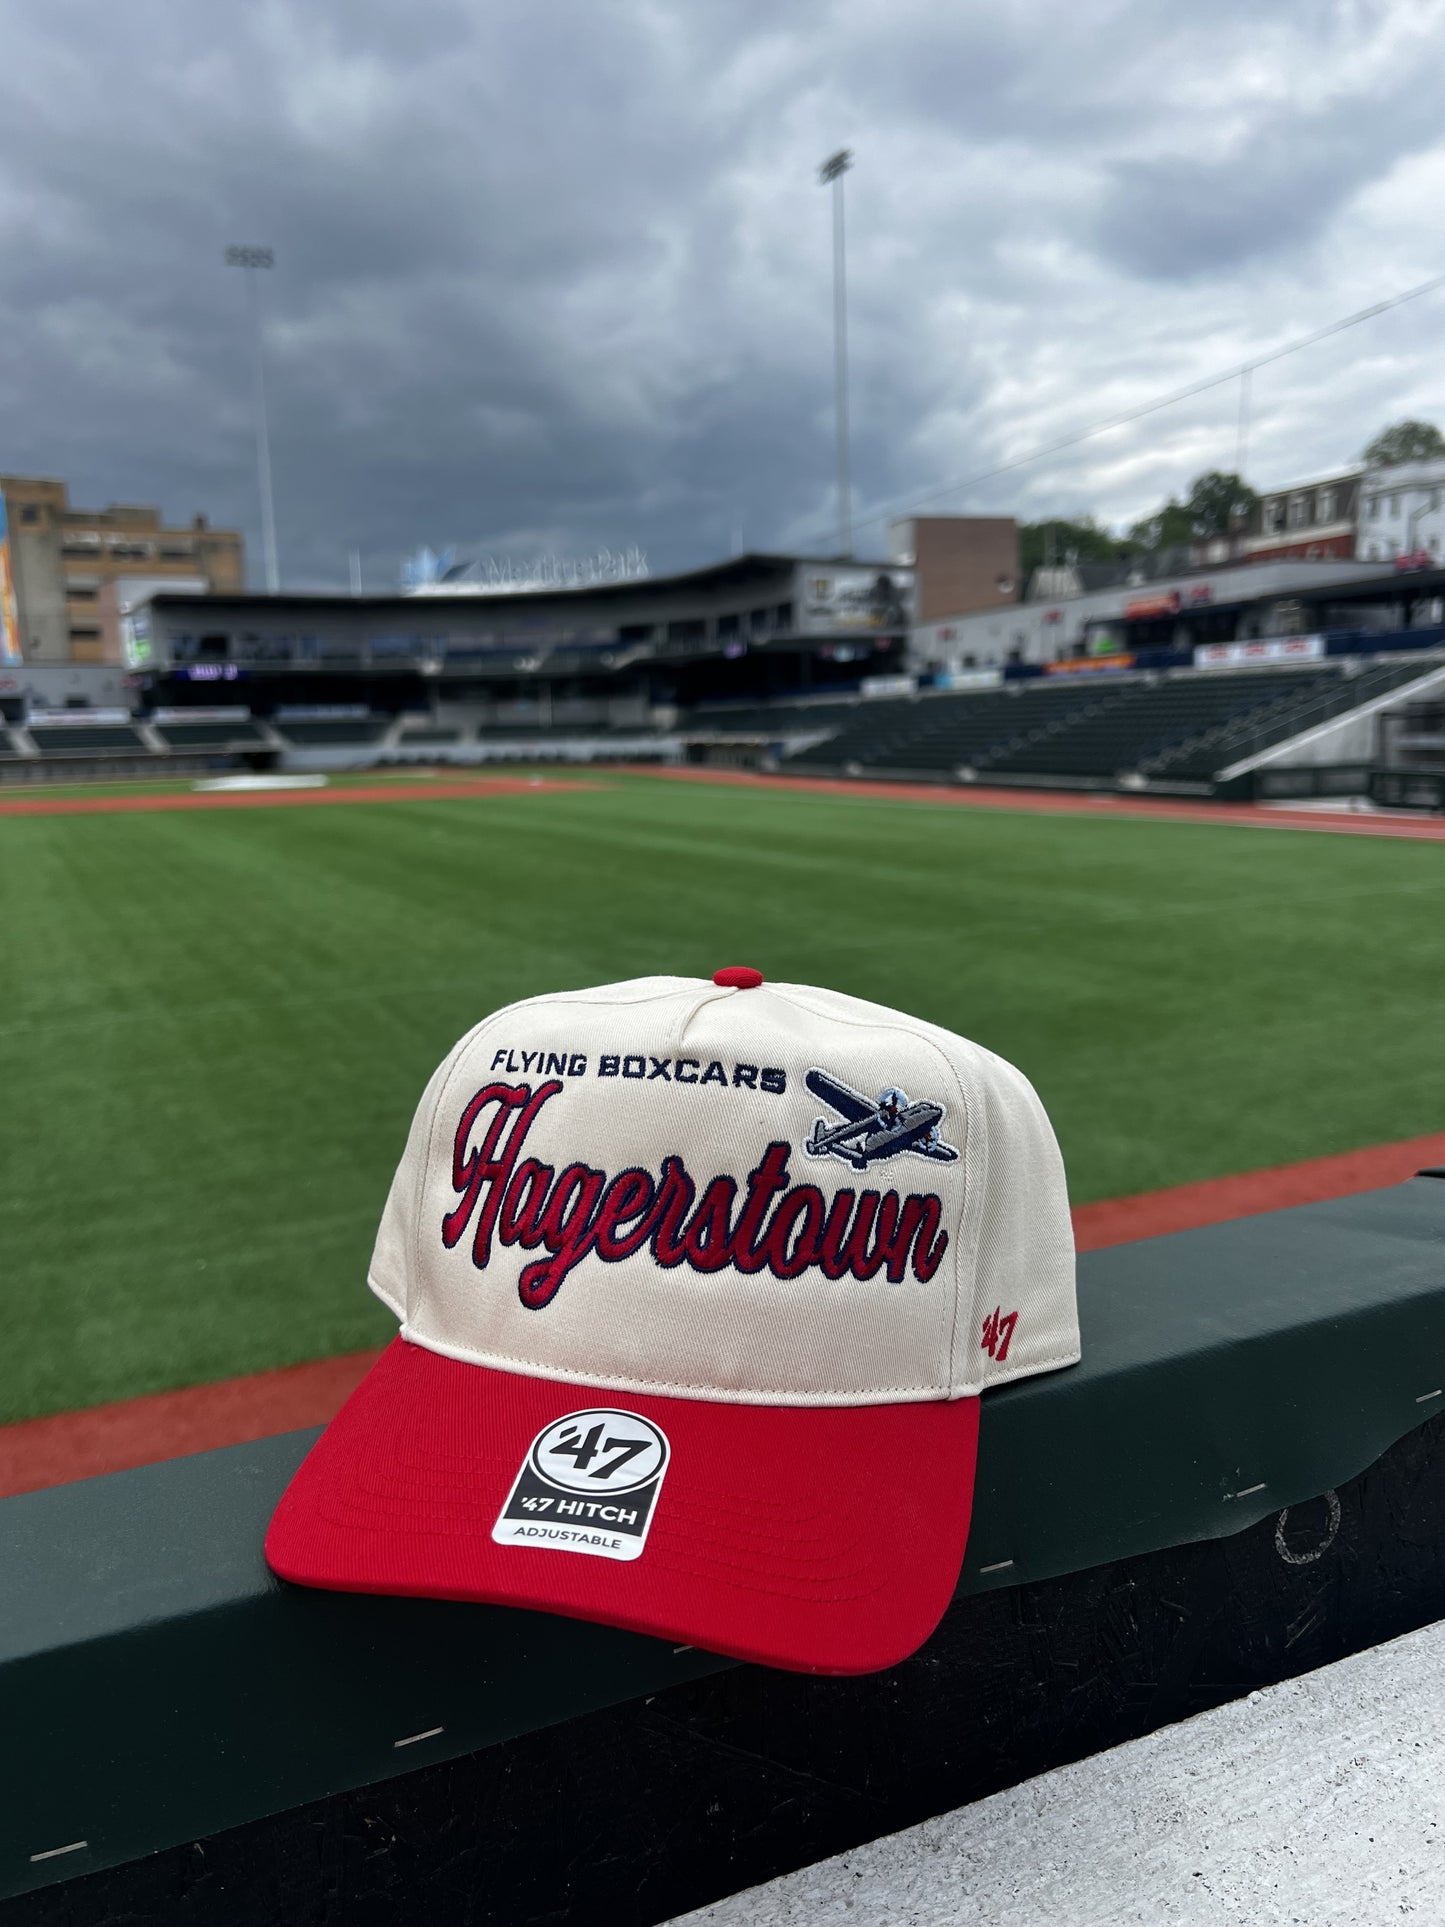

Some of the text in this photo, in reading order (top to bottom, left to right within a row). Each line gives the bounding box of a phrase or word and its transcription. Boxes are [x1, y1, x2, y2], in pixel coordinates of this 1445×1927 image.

[491, 1049, 786, 1094] FLYING BOXCARS
[442, 1080, 949, 1309] Hagerstown
[981, 1305, 1019, 1361] '47
[549, 1423, 653, 1479] '47
[521, 1497, 638, 1525] '47 HITCH
[513, 1526, 622, 1549] ADJUSTABLE
